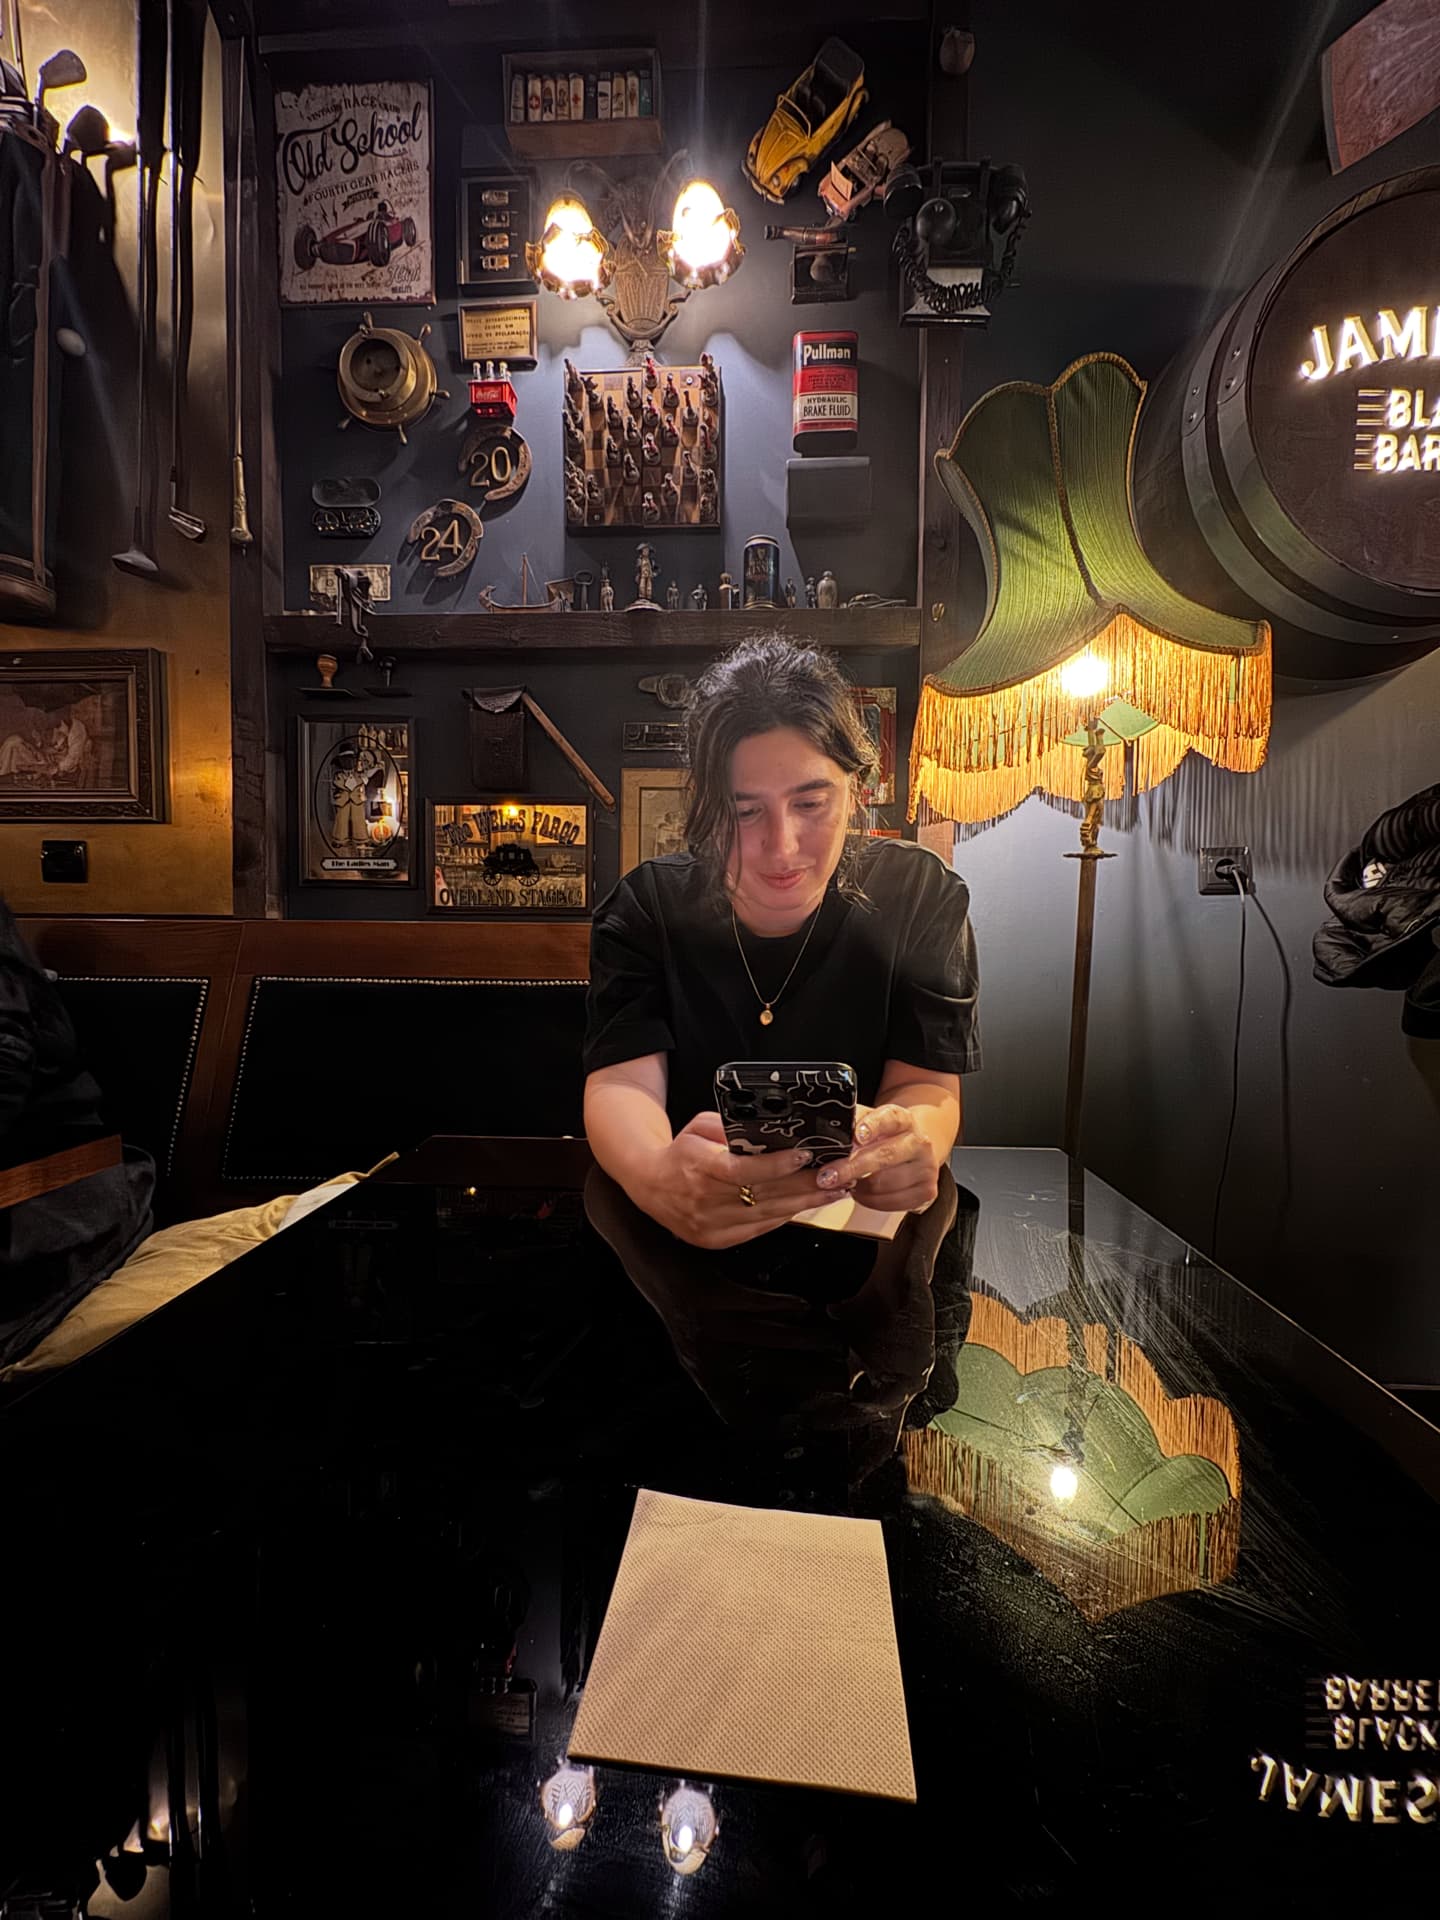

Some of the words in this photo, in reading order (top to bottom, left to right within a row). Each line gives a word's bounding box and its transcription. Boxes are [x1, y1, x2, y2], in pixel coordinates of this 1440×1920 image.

[283, 112, 342, 195] Old
[331, 101, 422, 174] School
[350, 174, 378, 190] GEAR
[380, 160, 419, 181] RACERS
[803, 343, 850, 366] Pullman
[803, 404, 827, 417] BRAKE
[829, 404, 851, 417] FLUID
[807, 396, 848, 404] HYDRAULIC
[471, 446, 511, 487] 20
[421, 519, 463, 560] 24
[473, 808, 526, 835] WELLS
[530, 810, 580, 846] FARGO
[440, 888, 514, 906] OVERLAND
